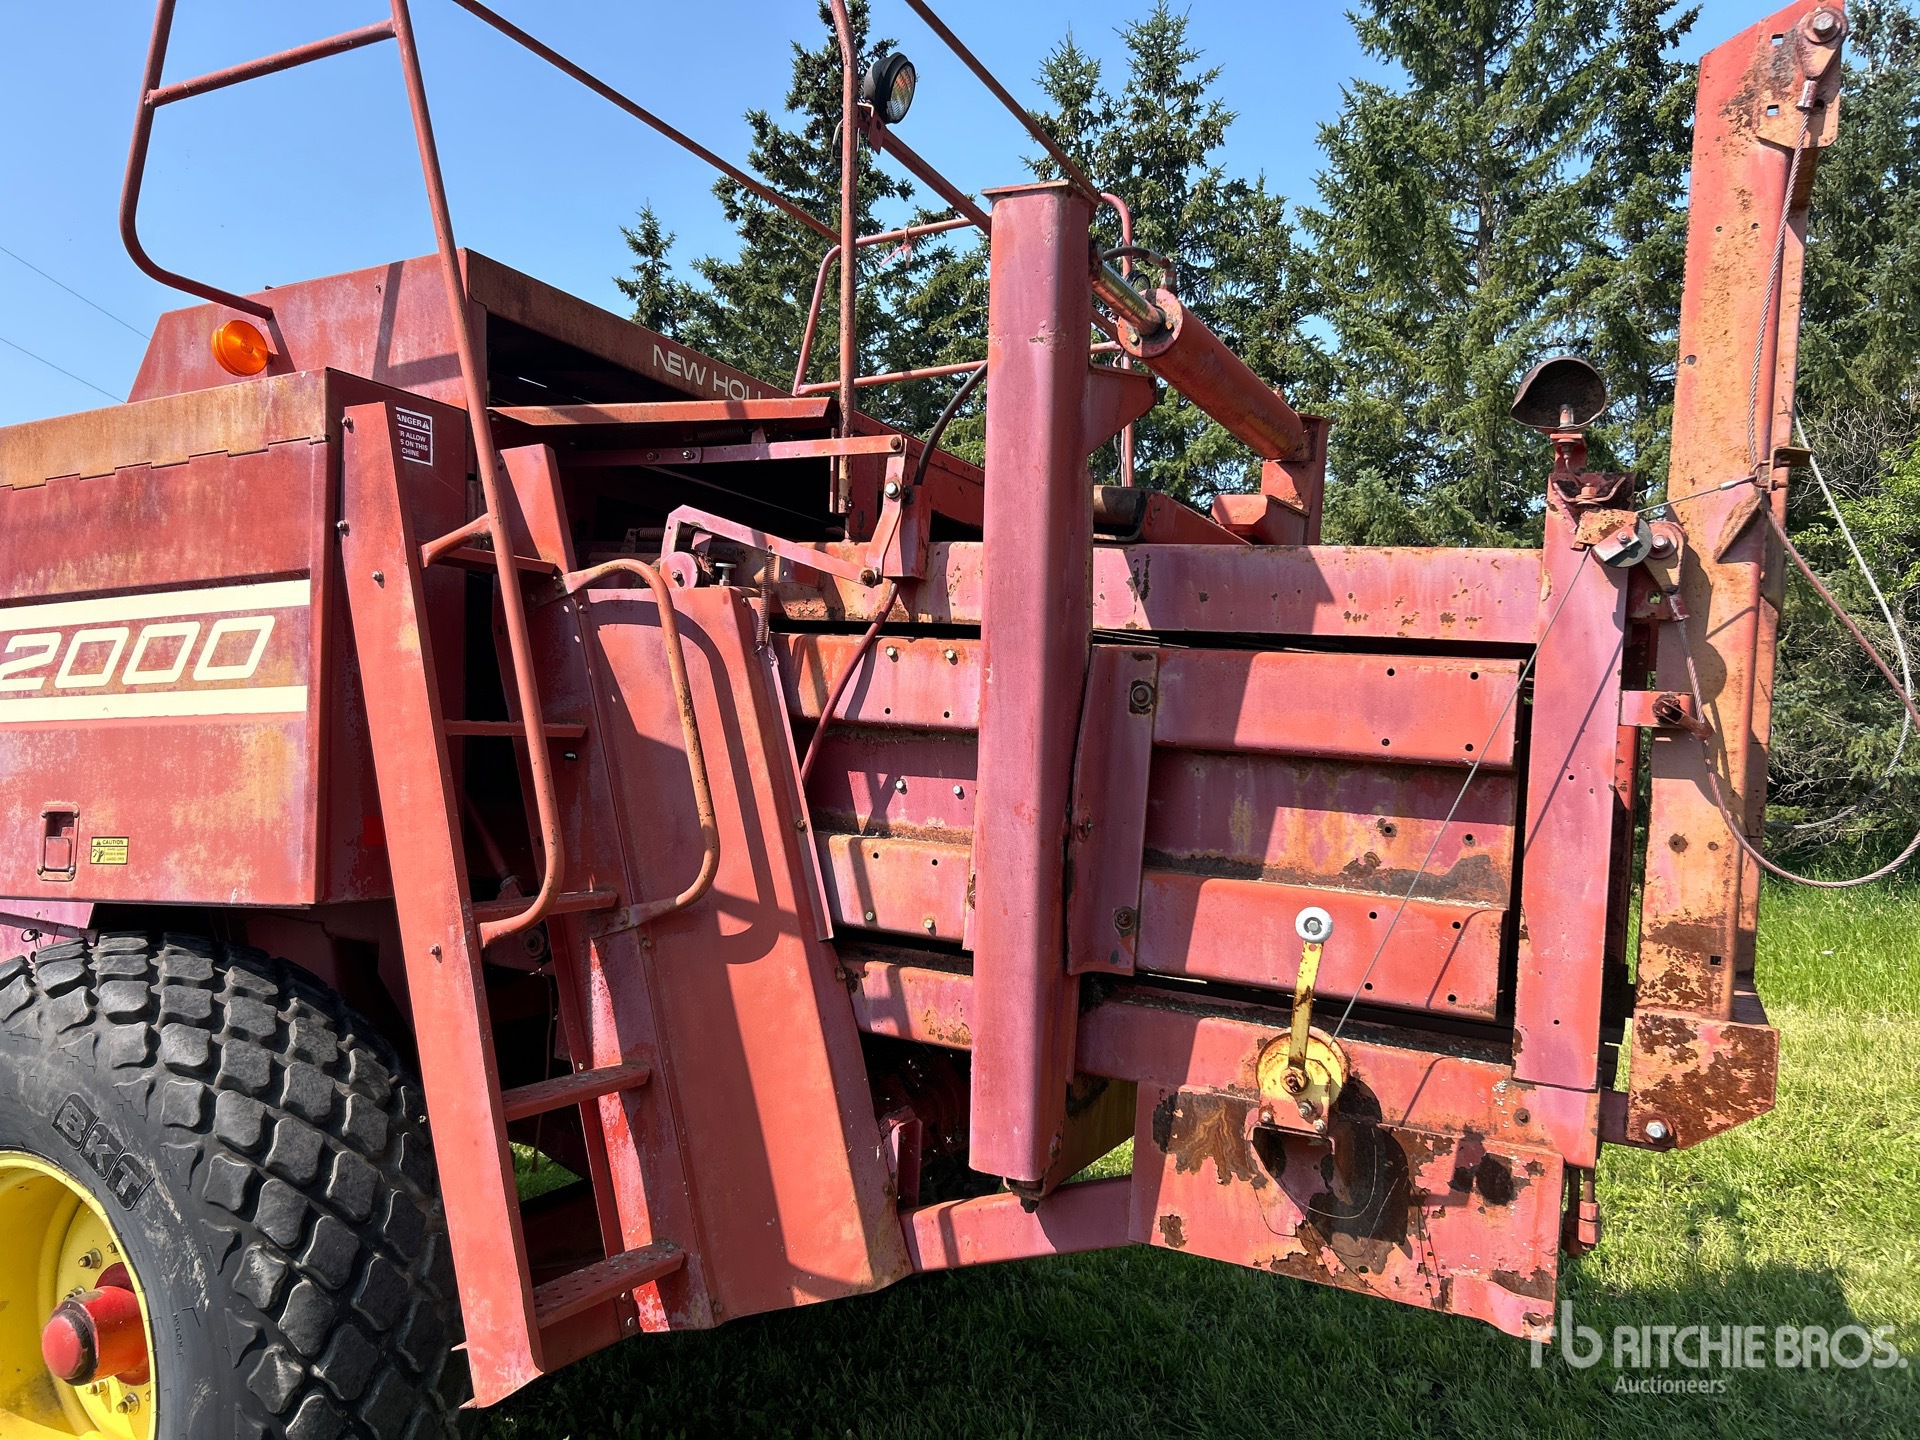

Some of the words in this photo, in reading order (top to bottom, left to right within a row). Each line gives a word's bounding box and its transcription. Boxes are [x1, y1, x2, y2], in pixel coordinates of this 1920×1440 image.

[653, 344, 707, 386] NEW
[396, 413, 422, 427] ANGER
[405, 432, 426, 443] ALLOW
[401, 447, 420, 457] CHINE
[405, 439, 414, 448] ON
[415, 442, 428, 451] THIS
[0, 614, 276, 692] 2000
[56, 1100, 144, 1198] BKT
